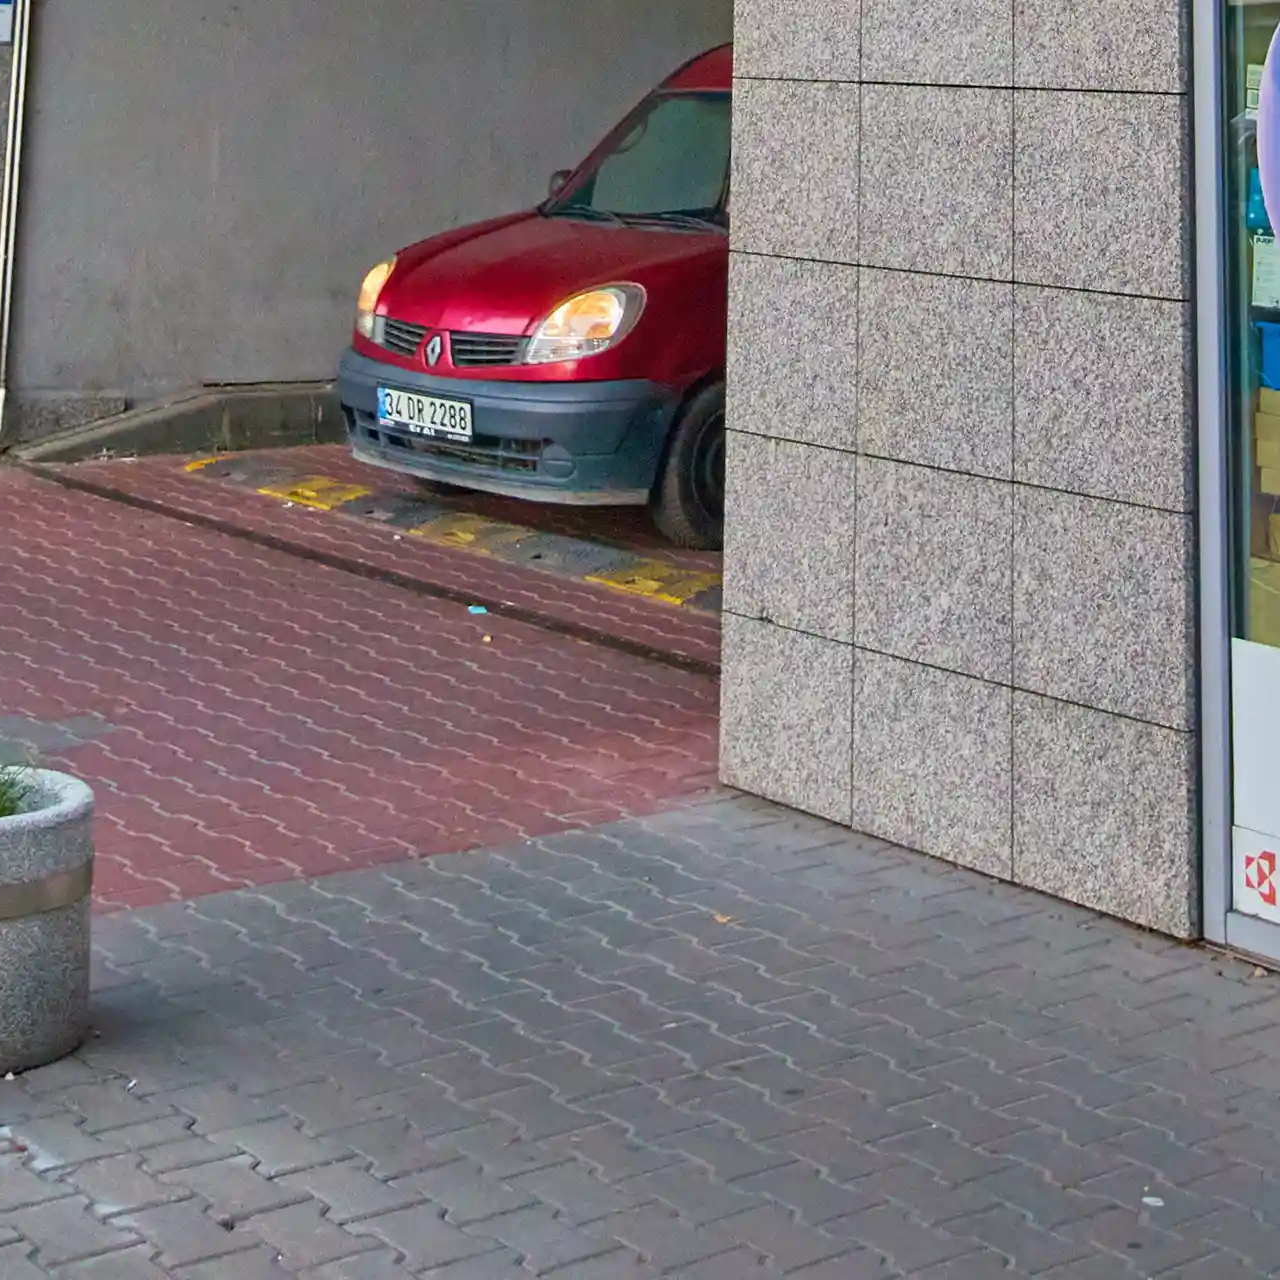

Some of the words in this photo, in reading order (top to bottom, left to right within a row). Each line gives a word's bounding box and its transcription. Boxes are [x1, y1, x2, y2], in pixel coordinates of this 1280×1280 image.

[384, 392, 402, 418] 34
[408, 397, 425, 424] DR
[430, 401, 468, 431] 2288
